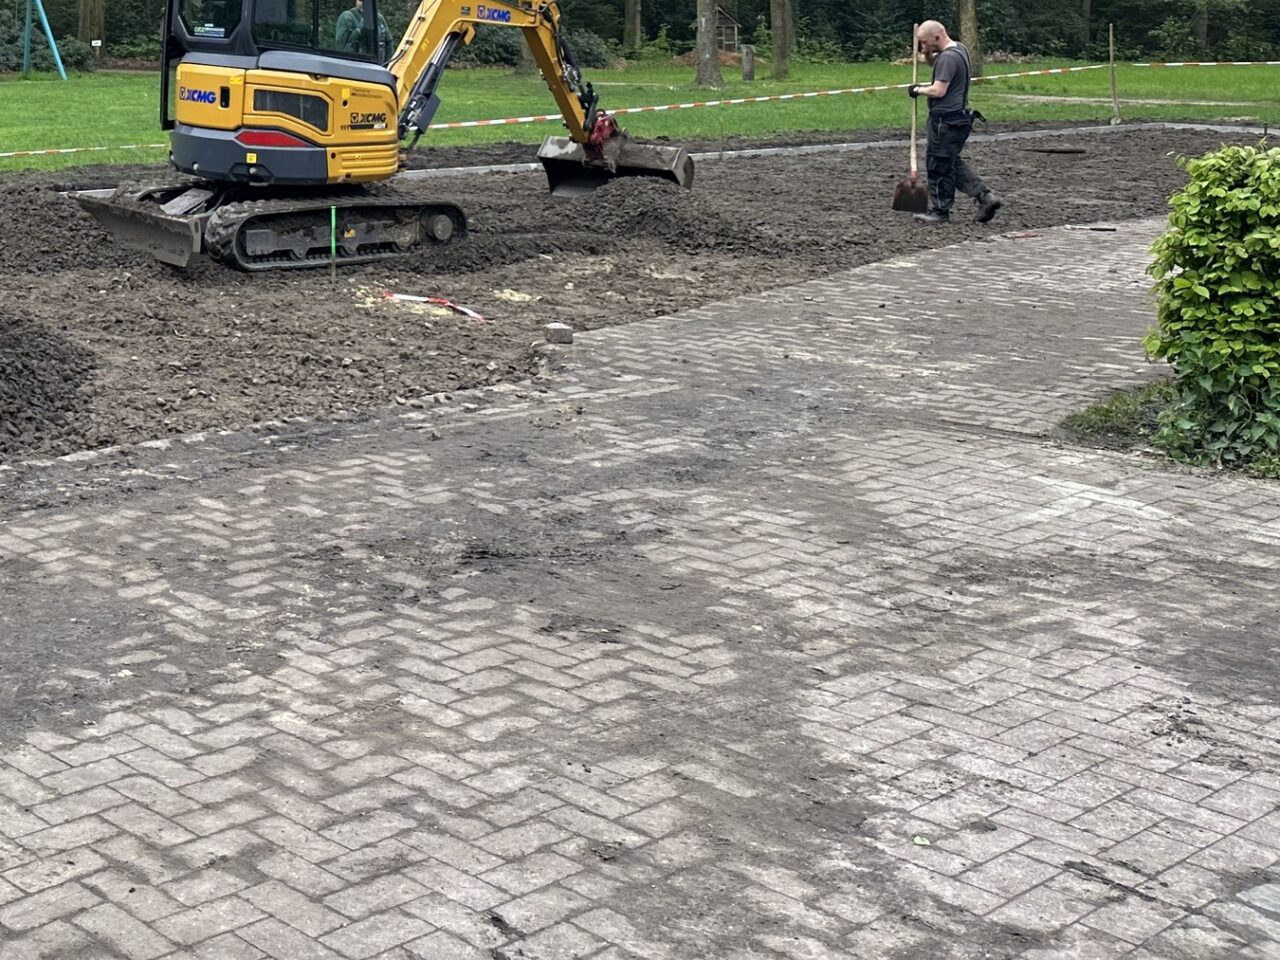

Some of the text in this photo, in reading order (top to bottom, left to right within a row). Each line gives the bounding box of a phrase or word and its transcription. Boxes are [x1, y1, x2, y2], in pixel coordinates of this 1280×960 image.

[486, 7, 511, 22] XCMG
[186, 89, 216, 104] XCMG
[359, 112, 386, 123] XCMG
